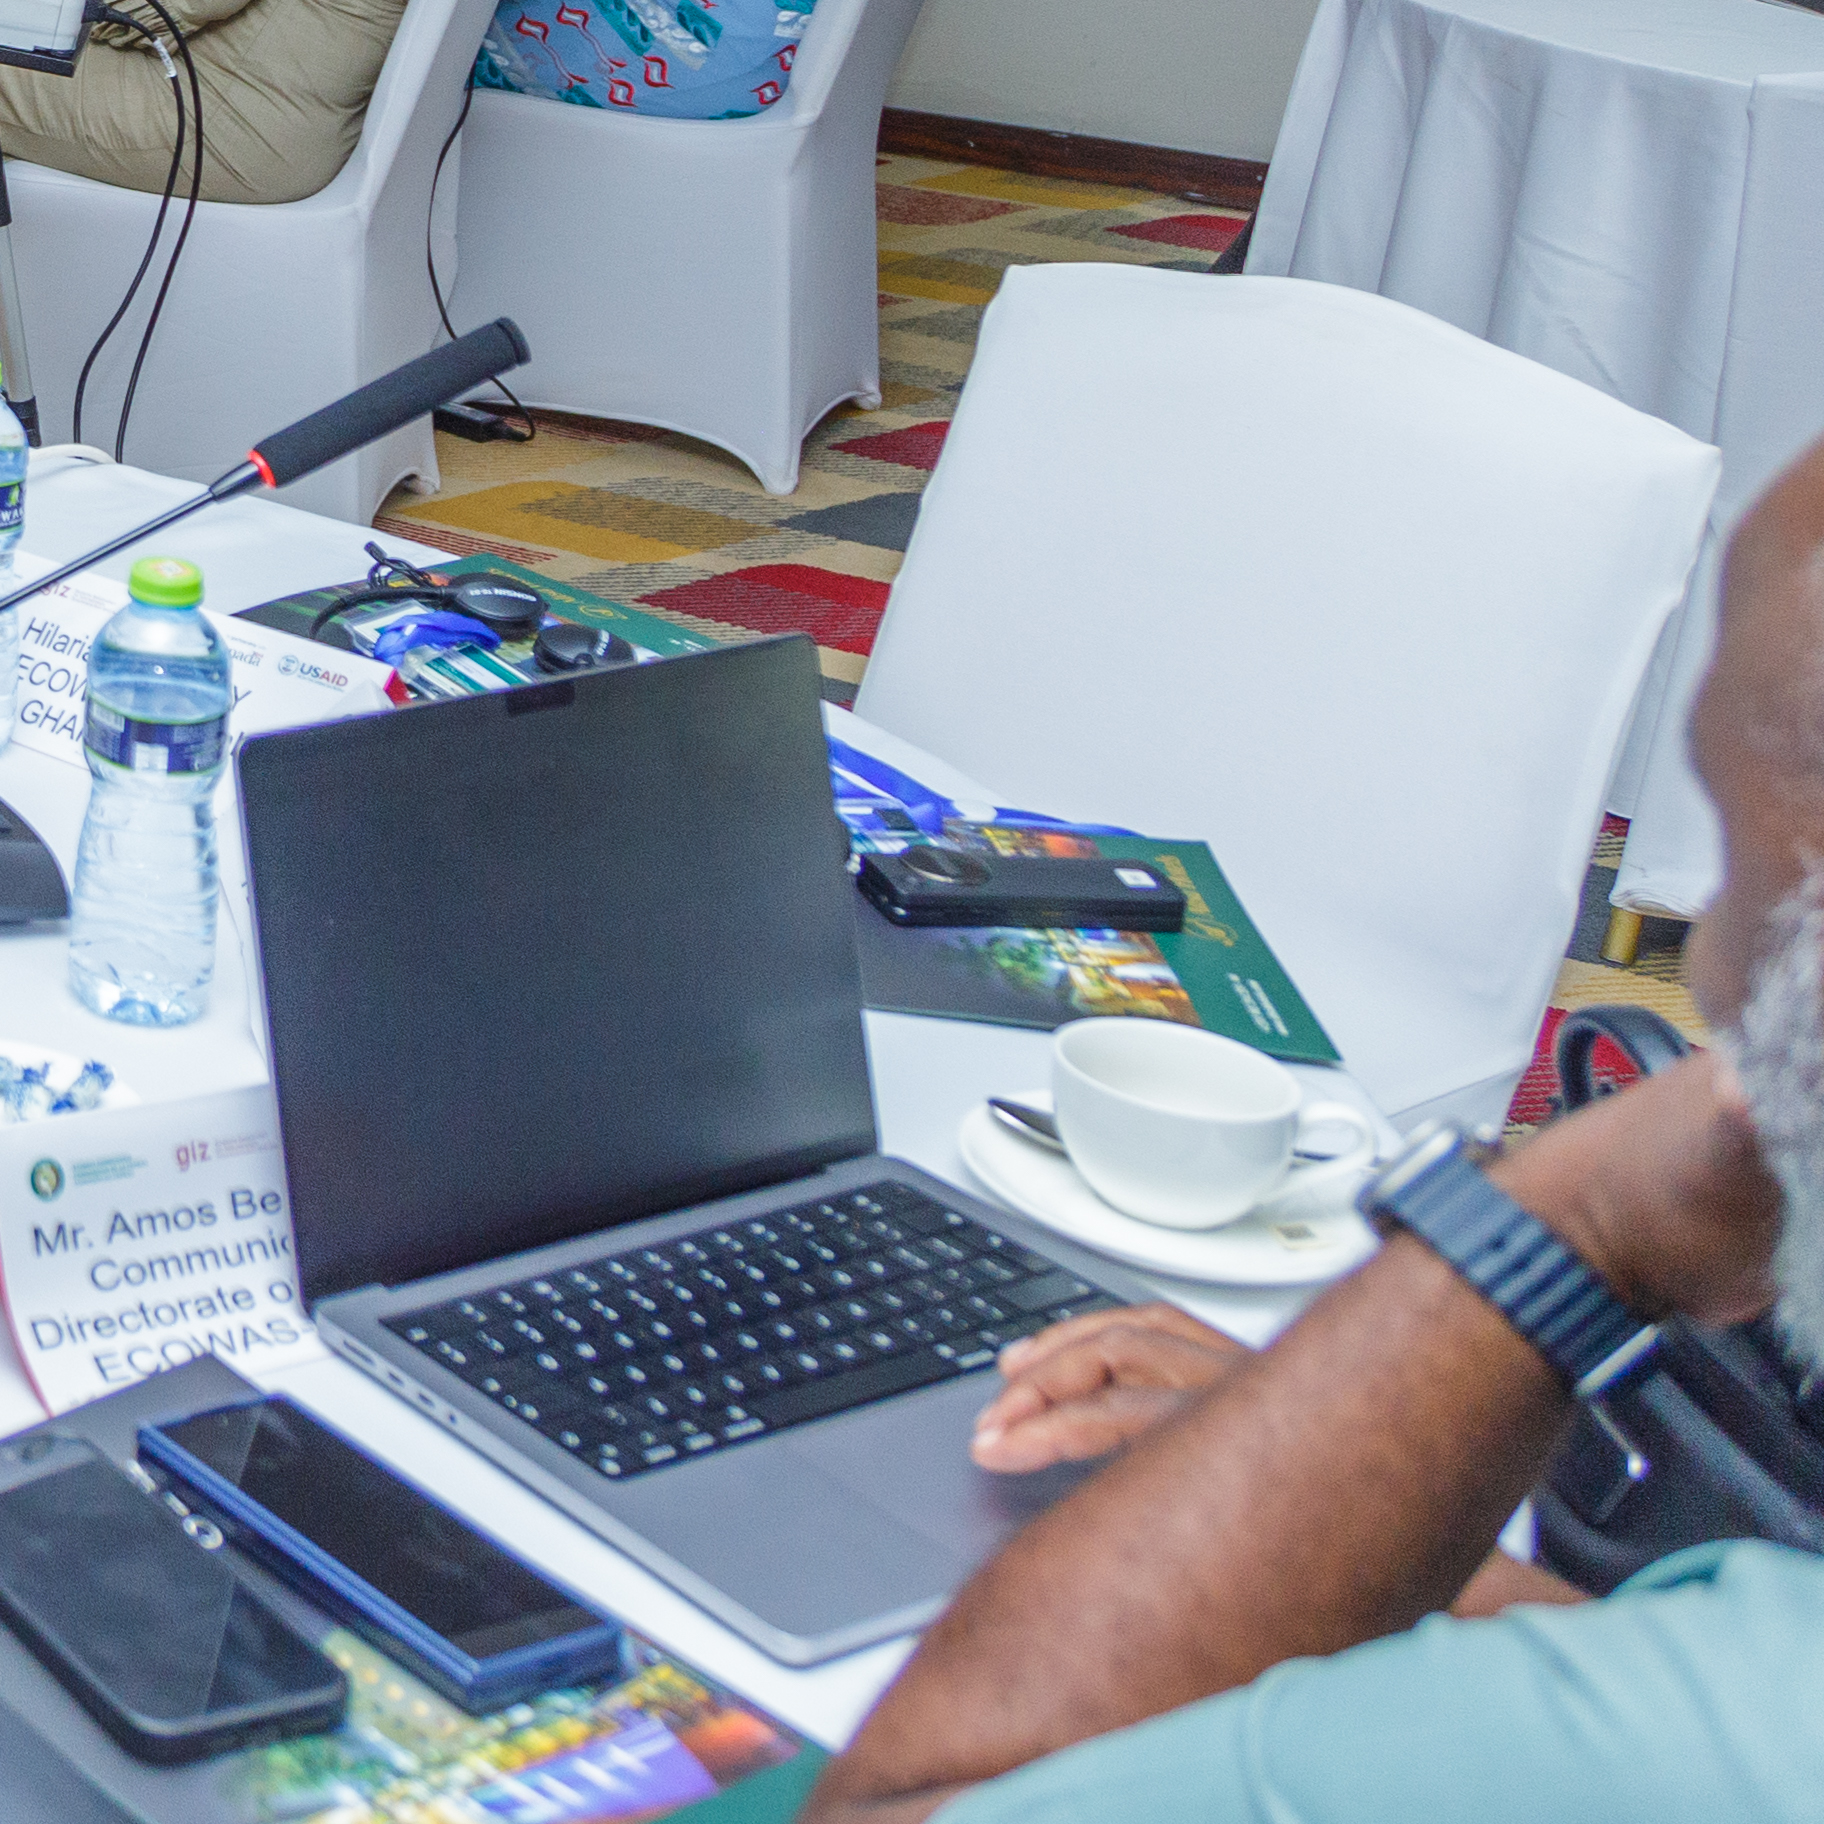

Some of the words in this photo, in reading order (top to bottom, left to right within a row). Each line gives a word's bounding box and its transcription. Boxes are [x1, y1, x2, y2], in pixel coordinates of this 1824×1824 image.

[299, 662, 349, 688] USAID
[33, 1223, 94, 1257] Mr.
[107, 1199, 218, 1245] Amos
[30, 1285, 257, 1350] Directorate
